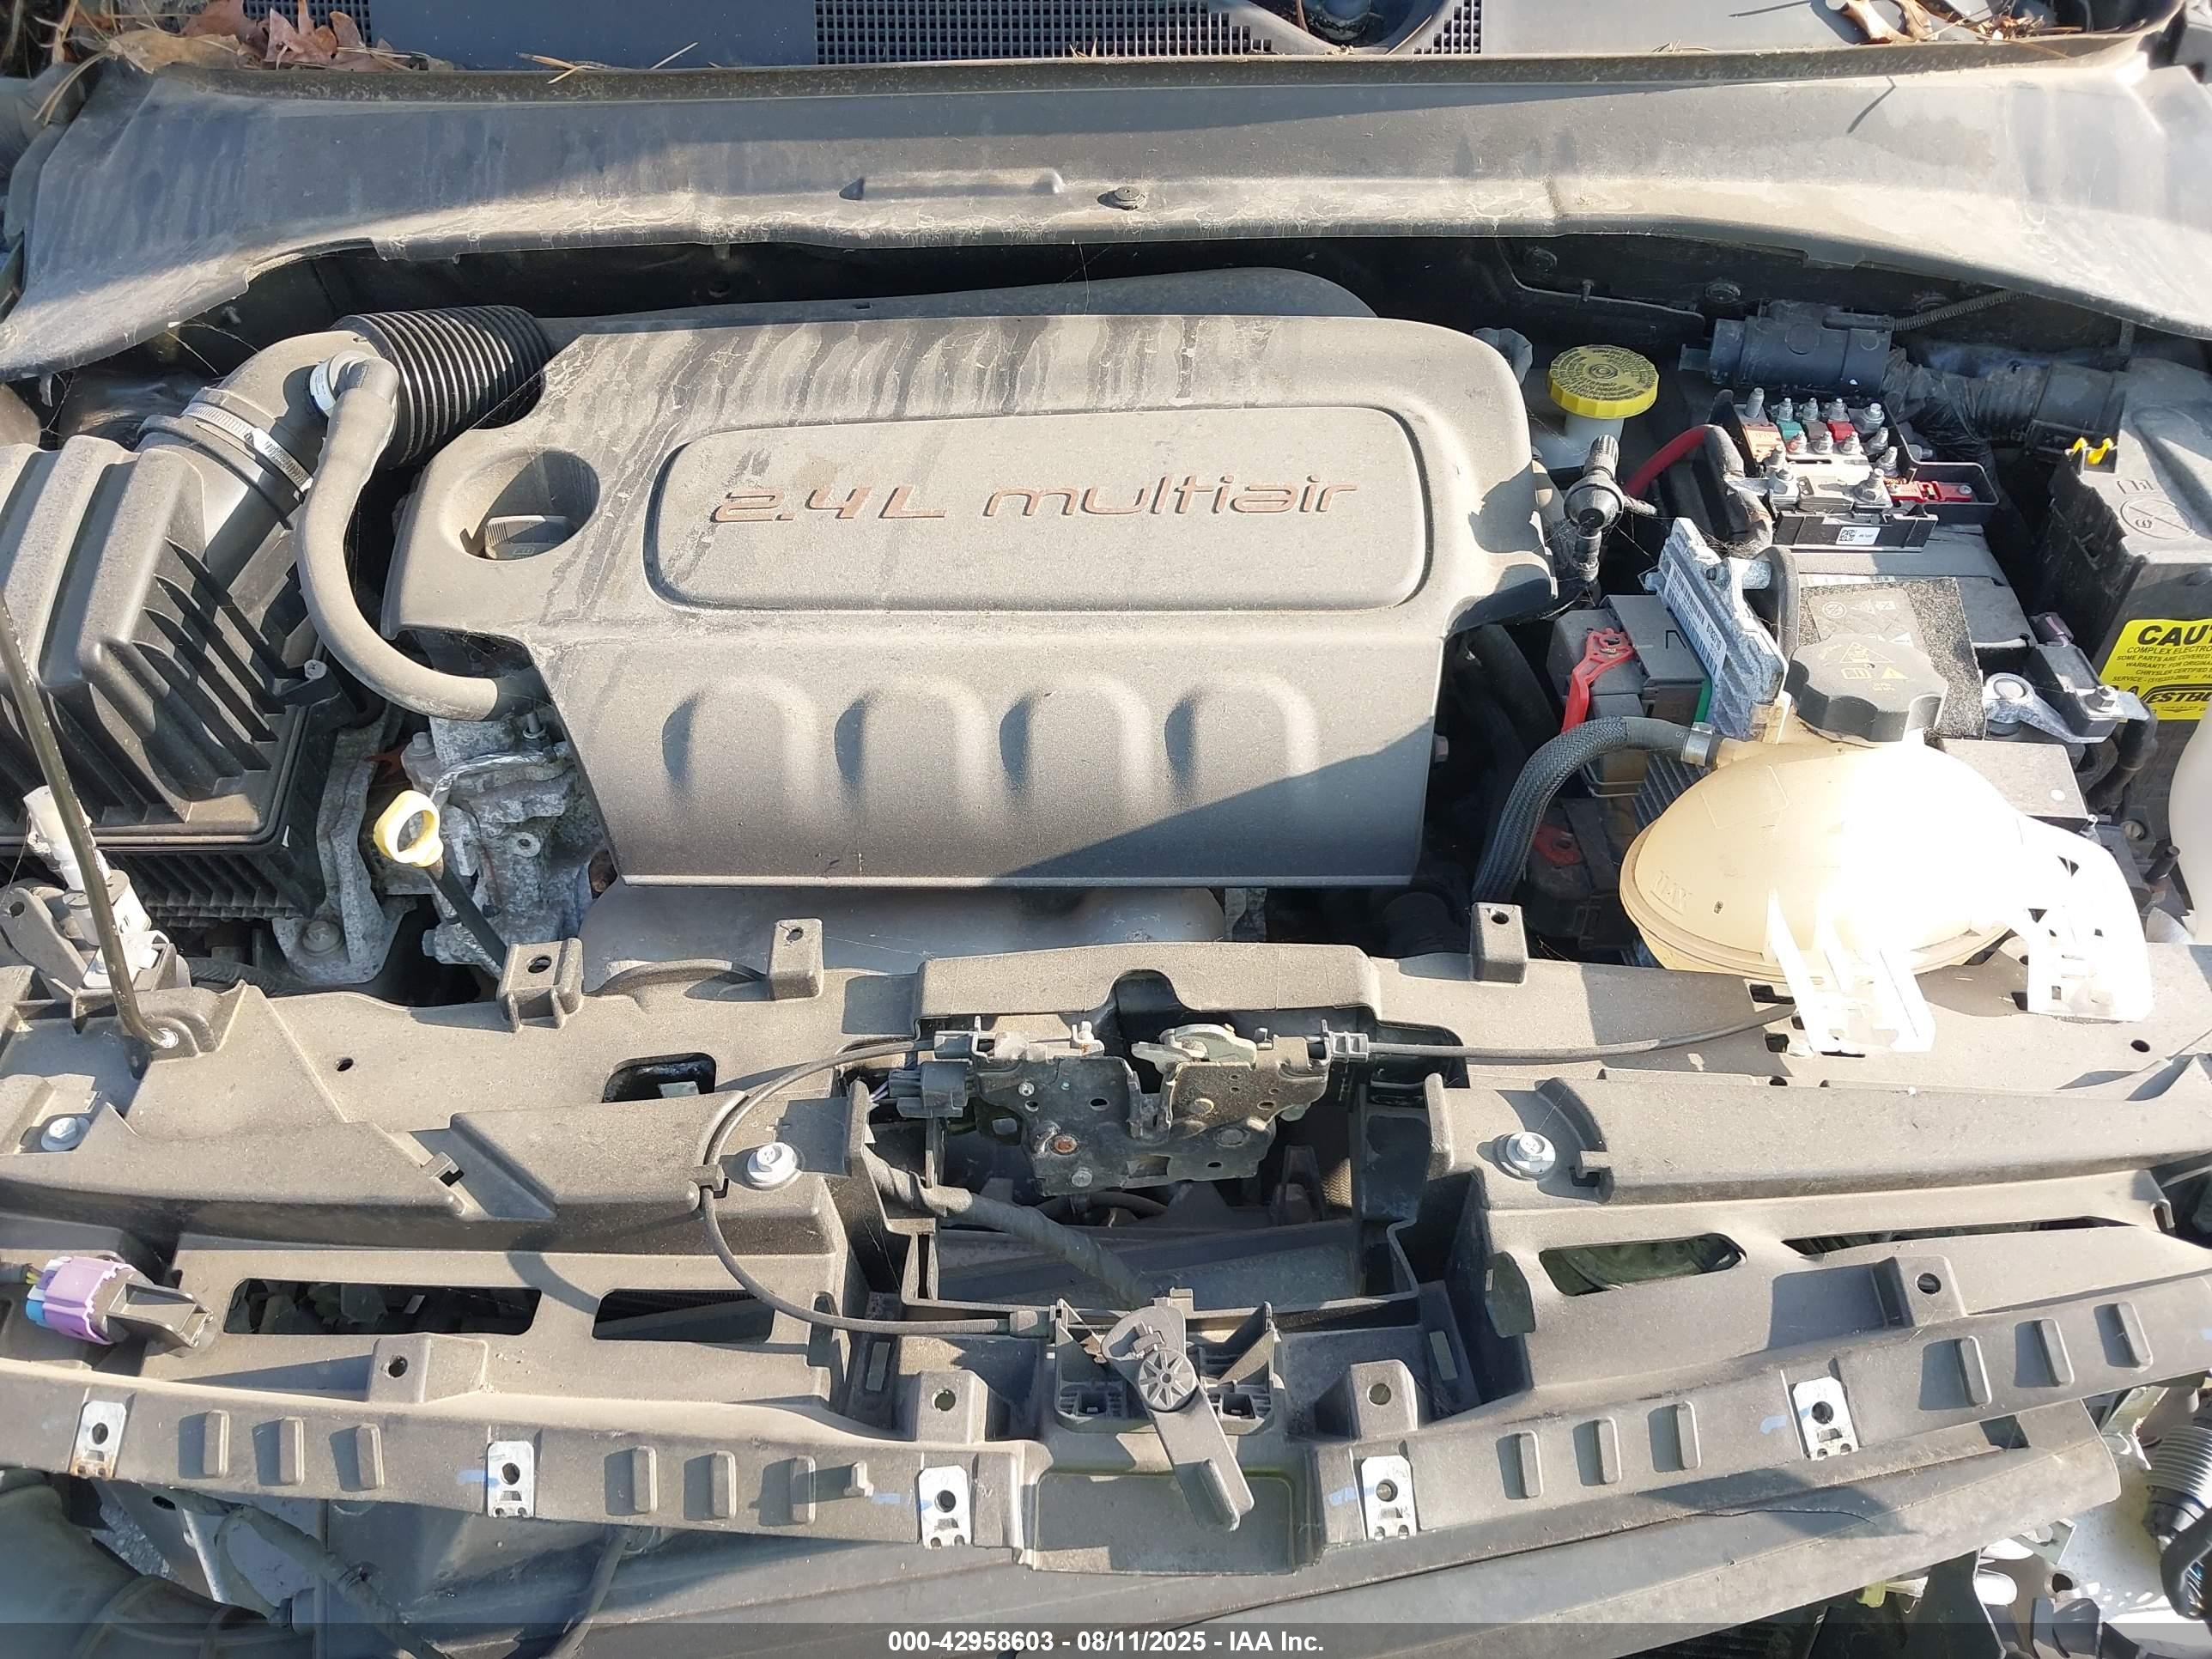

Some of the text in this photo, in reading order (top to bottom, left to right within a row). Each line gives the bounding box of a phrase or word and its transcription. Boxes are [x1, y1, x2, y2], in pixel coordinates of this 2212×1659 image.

[710, 473, 1360, 524] 2.4L multiair
[2137, 625, 2212, 646] CAU
